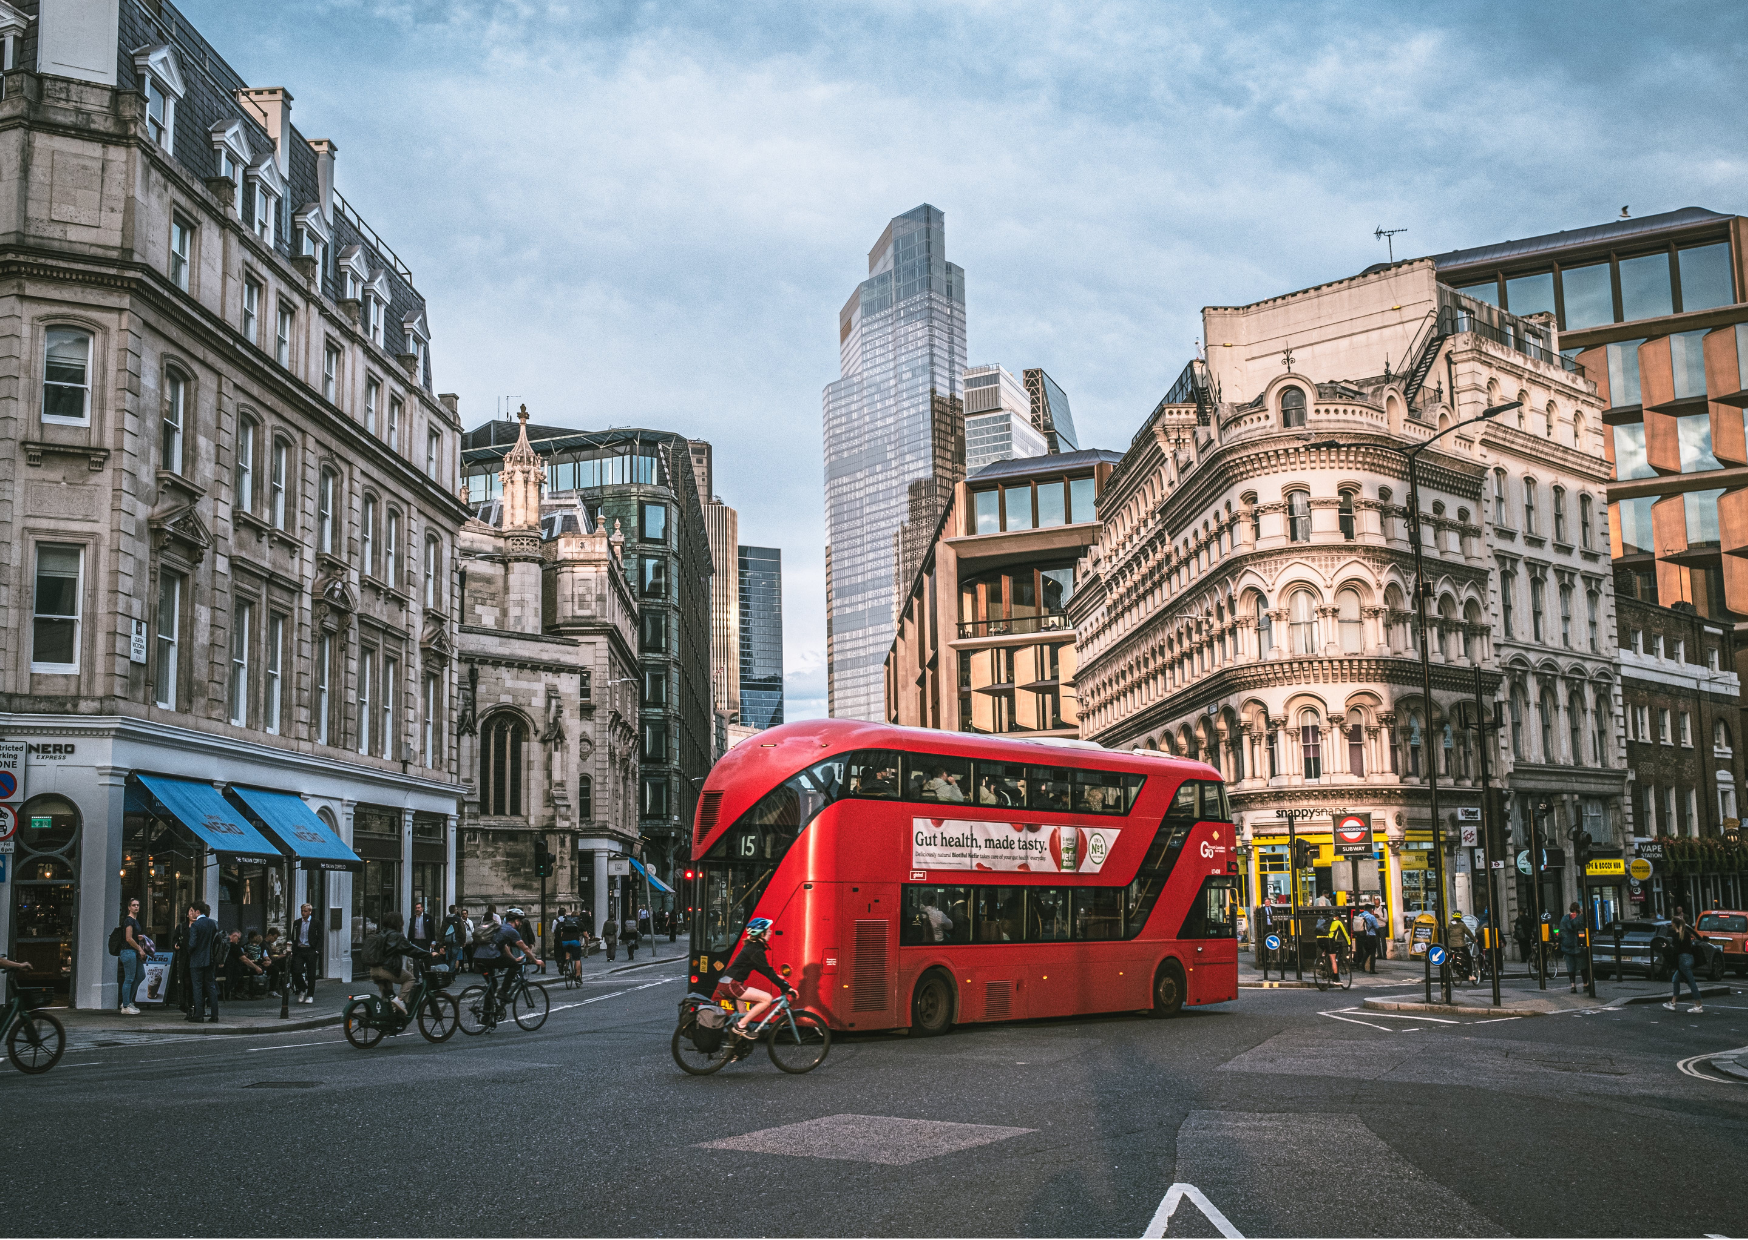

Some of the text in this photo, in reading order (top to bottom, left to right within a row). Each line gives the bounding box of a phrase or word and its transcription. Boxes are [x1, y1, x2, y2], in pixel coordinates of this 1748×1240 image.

[28, 743, 75, 754] NERO
[201, 821, 245, 836] NERO
[741, 835, 756, 857] 15
[915, 831, 938, 847] Gut
[940, 832, 982, 851] health,
[984, 835, 1016, 850] made
[1017, 837, 1048, 854] tasty.
[1641, 845, 1662, 853] VAPE
